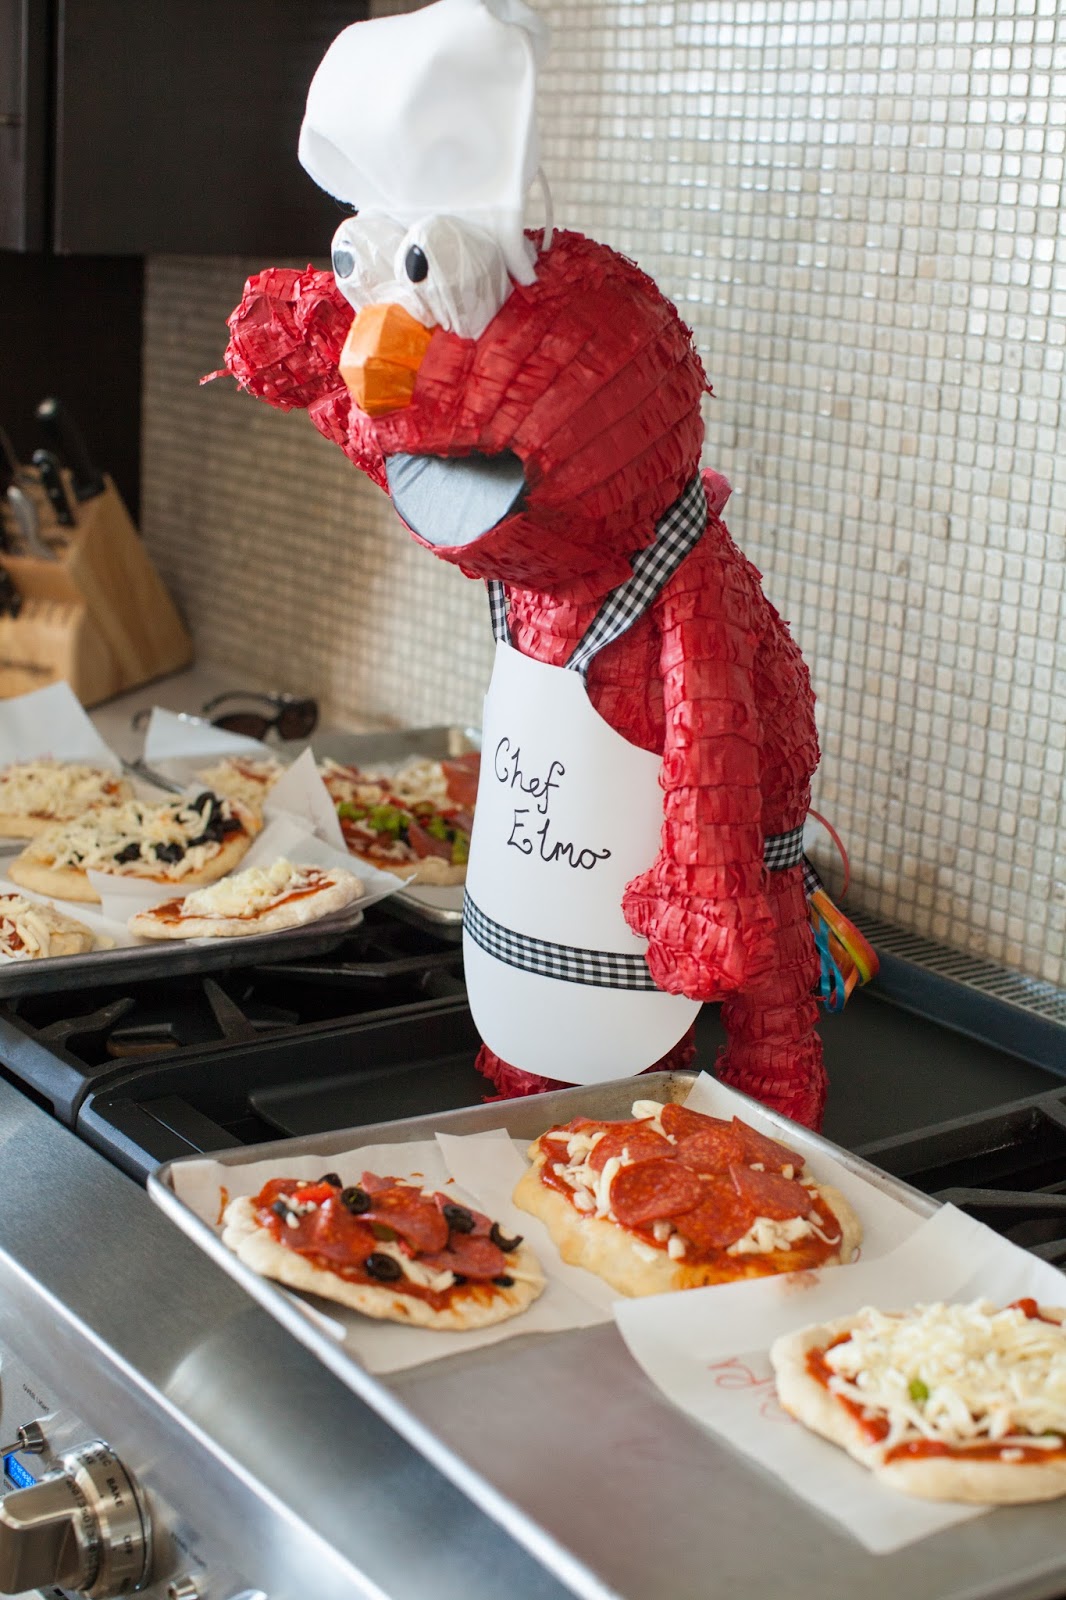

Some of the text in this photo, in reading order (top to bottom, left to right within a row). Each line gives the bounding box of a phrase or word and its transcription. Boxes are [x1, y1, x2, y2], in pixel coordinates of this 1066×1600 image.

[494, 736, 566, 815] Chef
[506, 808, 612, 870] Elmo
[106, 1477, 125, 1508] BAKE
